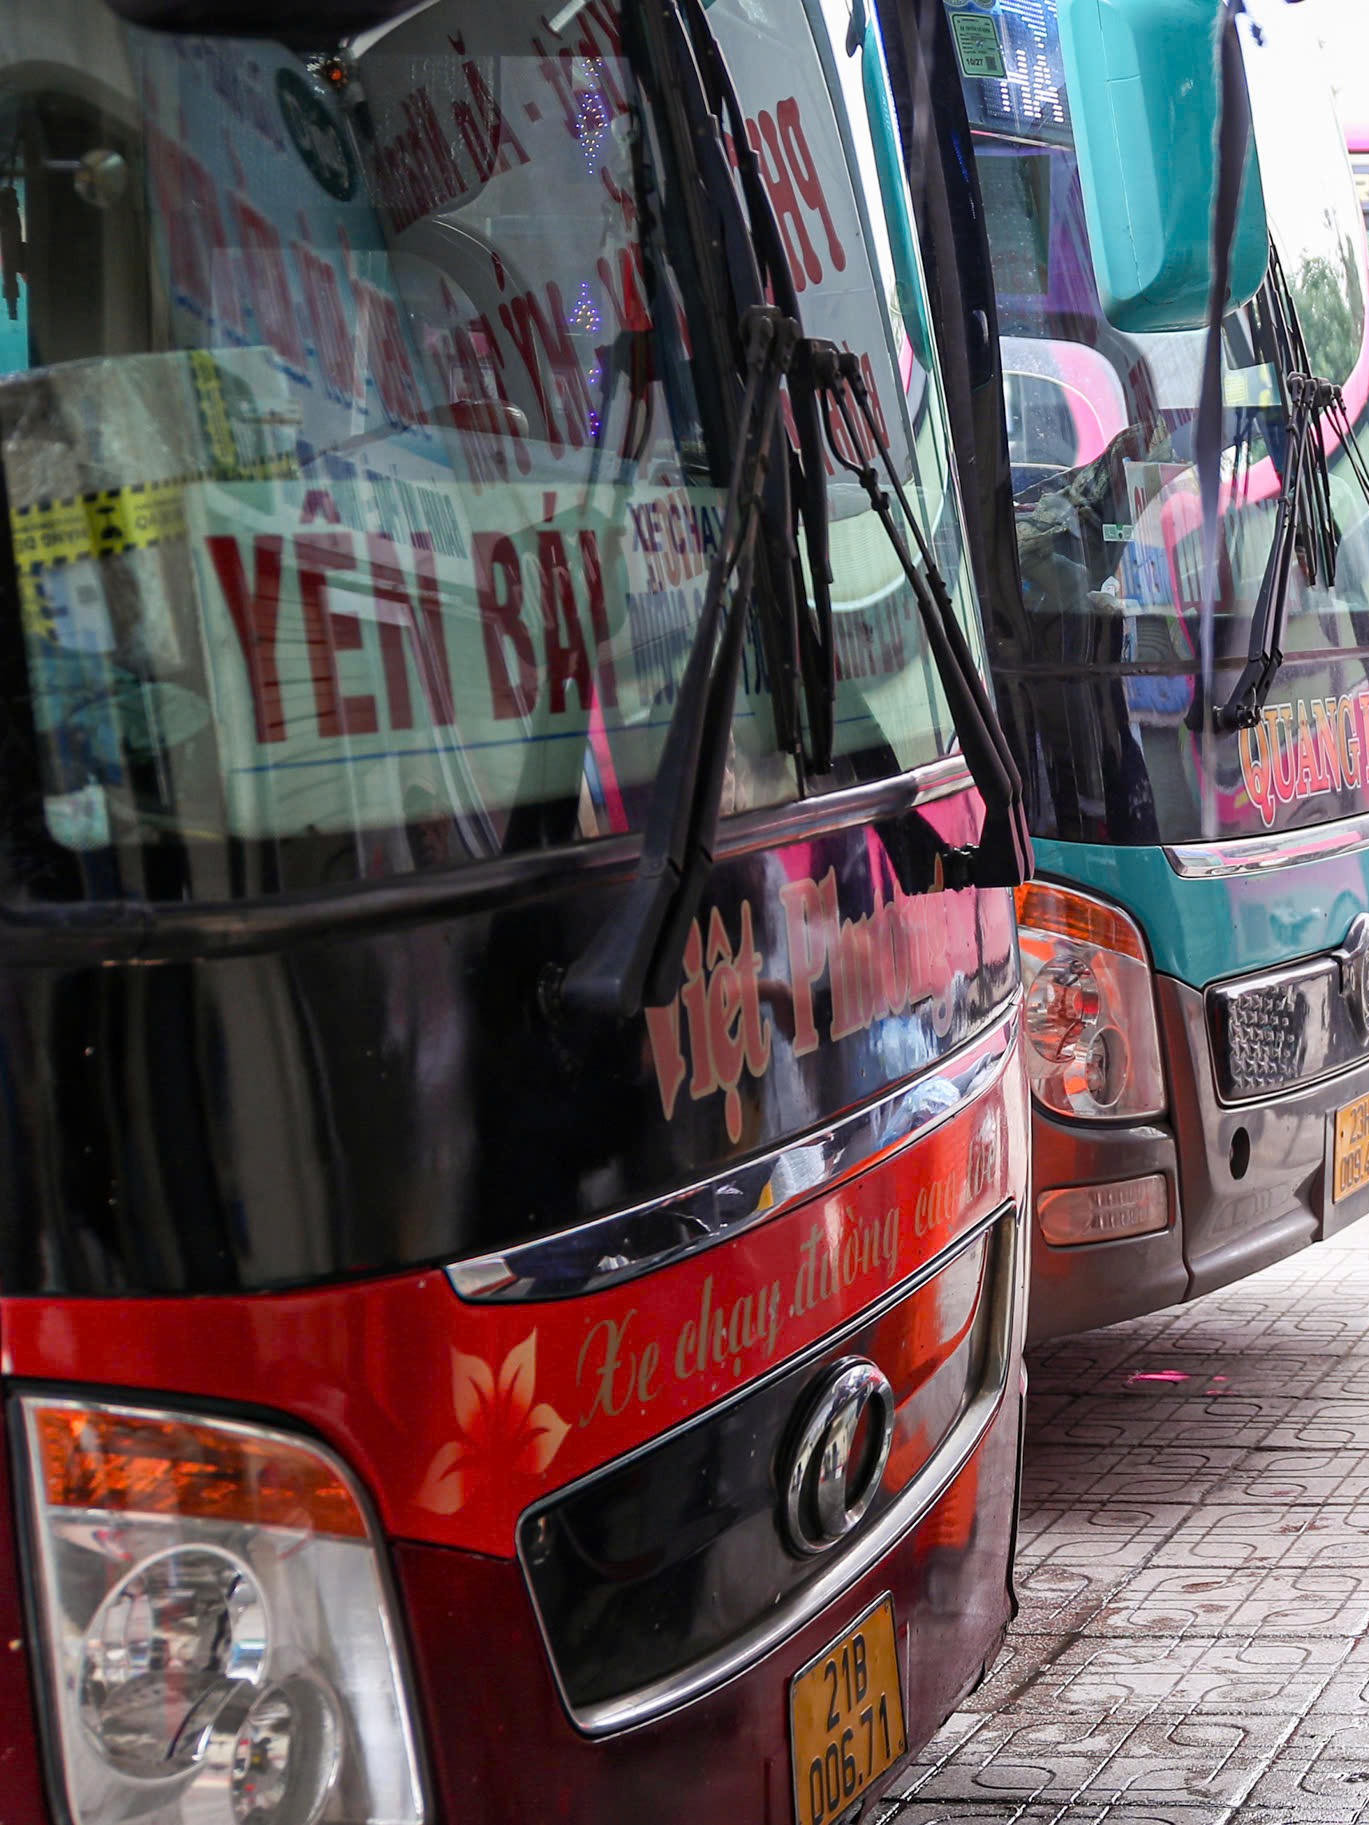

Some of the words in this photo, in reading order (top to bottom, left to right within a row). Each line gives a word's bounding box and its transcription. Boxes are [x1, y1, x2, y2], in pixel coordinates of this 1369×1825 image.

[205, 490, 456, 745] YÊN
[472, 491, 618, 721] BÁI
[1238, 694, 1361, 828] QUANG
[576, 1308, 661, 1428] Xe
[675, 1273, 782, 1378] chạy
[824, 1631, 867, 1733] 21B
[809, 1692, 891, 1825] 006.71
